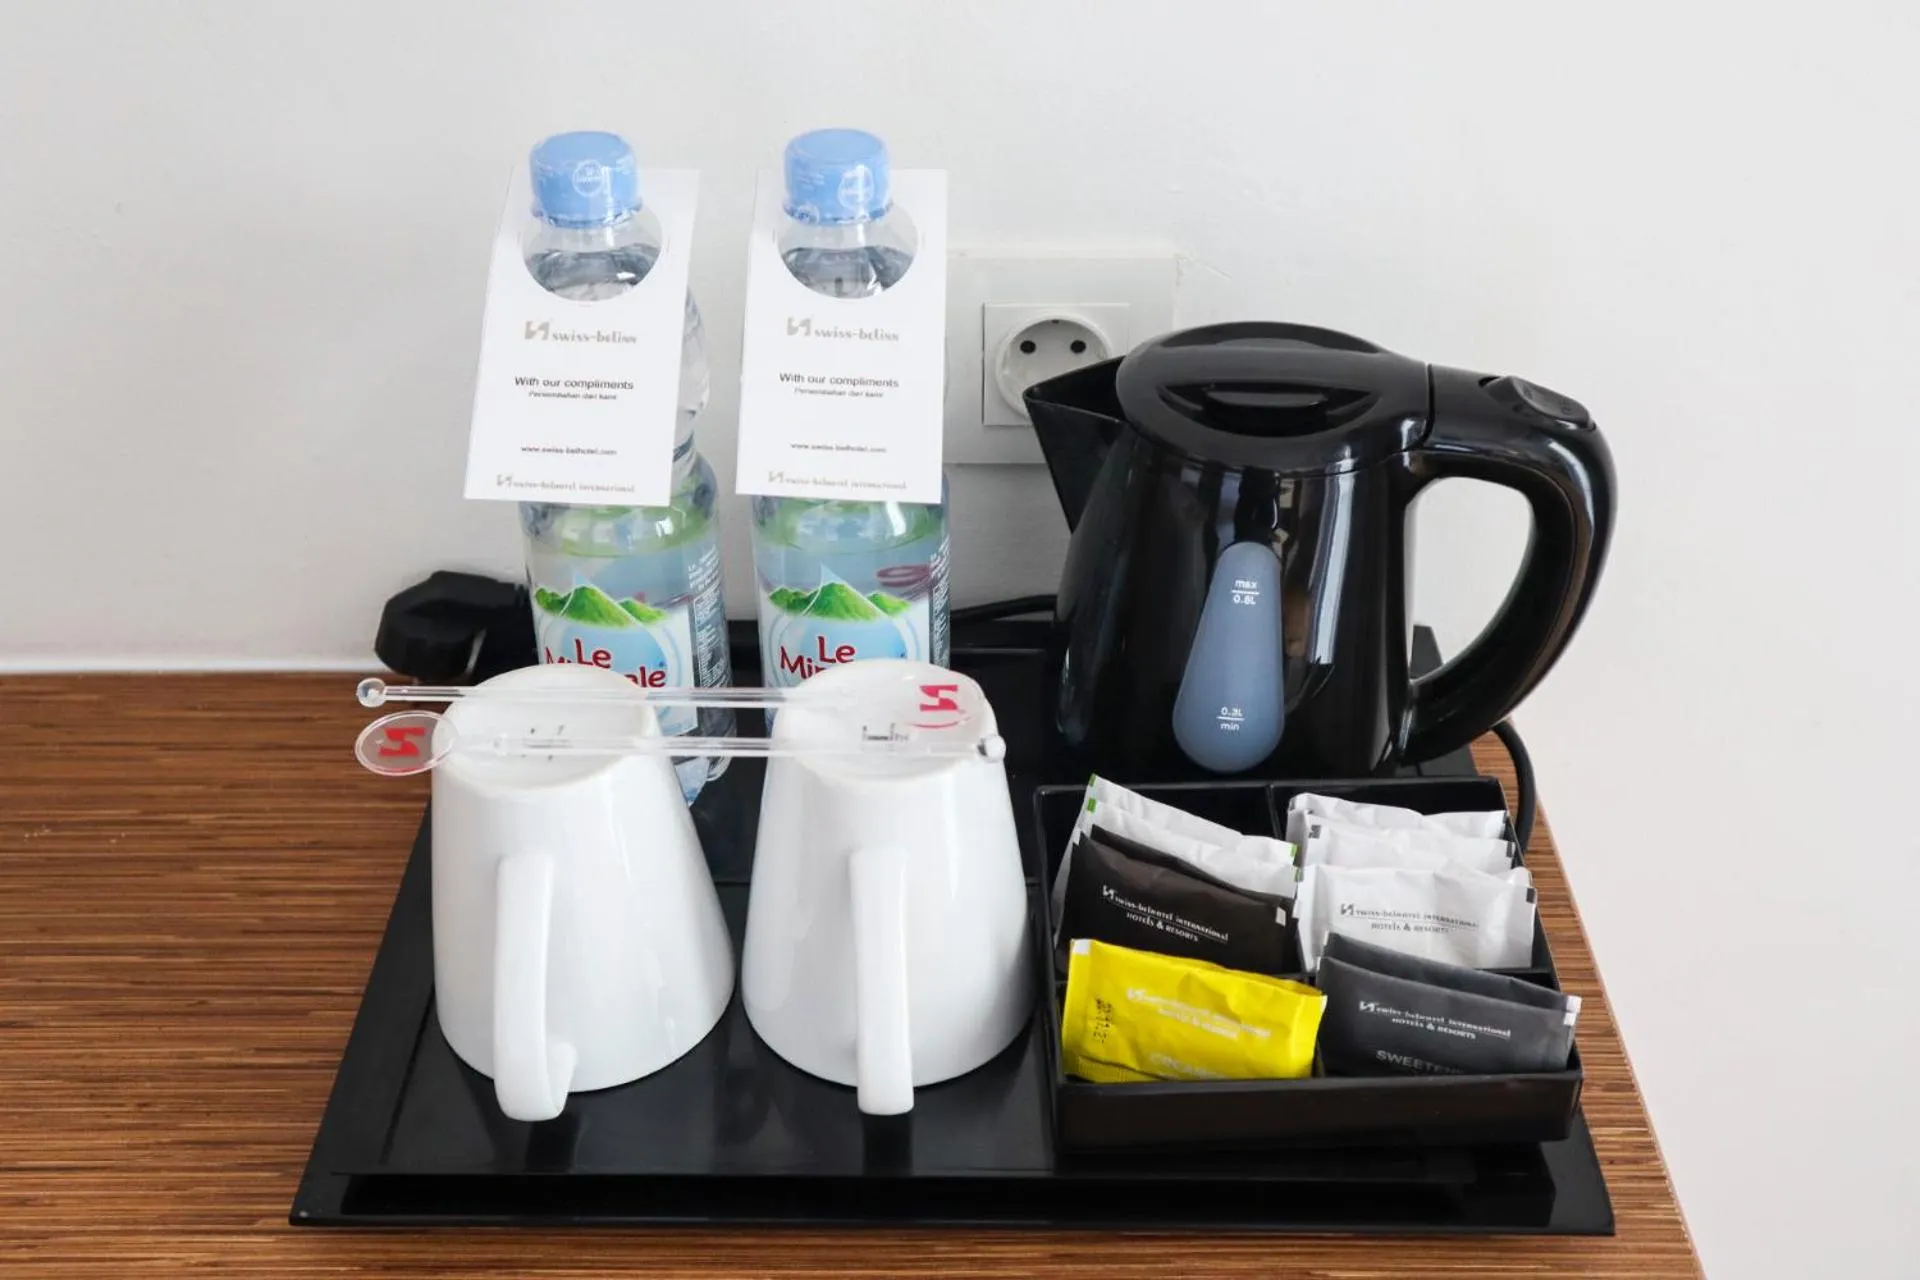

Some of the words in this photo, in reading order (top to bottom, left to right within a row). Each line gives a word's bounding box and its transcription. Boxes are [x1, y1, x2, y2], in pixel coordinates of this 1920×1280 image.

[514, 376, 539, 386] With
[542, 379, 561, 387] our
[564, 379, 634, 391] compliments
[779, 373, 805, 383] With
[807, 376, 826, 384] our
[829, 376, 900, 388] compliments
[1235, 580, 1258, 589] max
[575, 638, 611, 669] Le
[818, 635, 856, 664] Le
[1220, 723, 1240, 731] min
[1156, 920, 1165, 930] &
[1403, 923, 1411, 931] &
[1426, 1022, 1436, 1031] &
